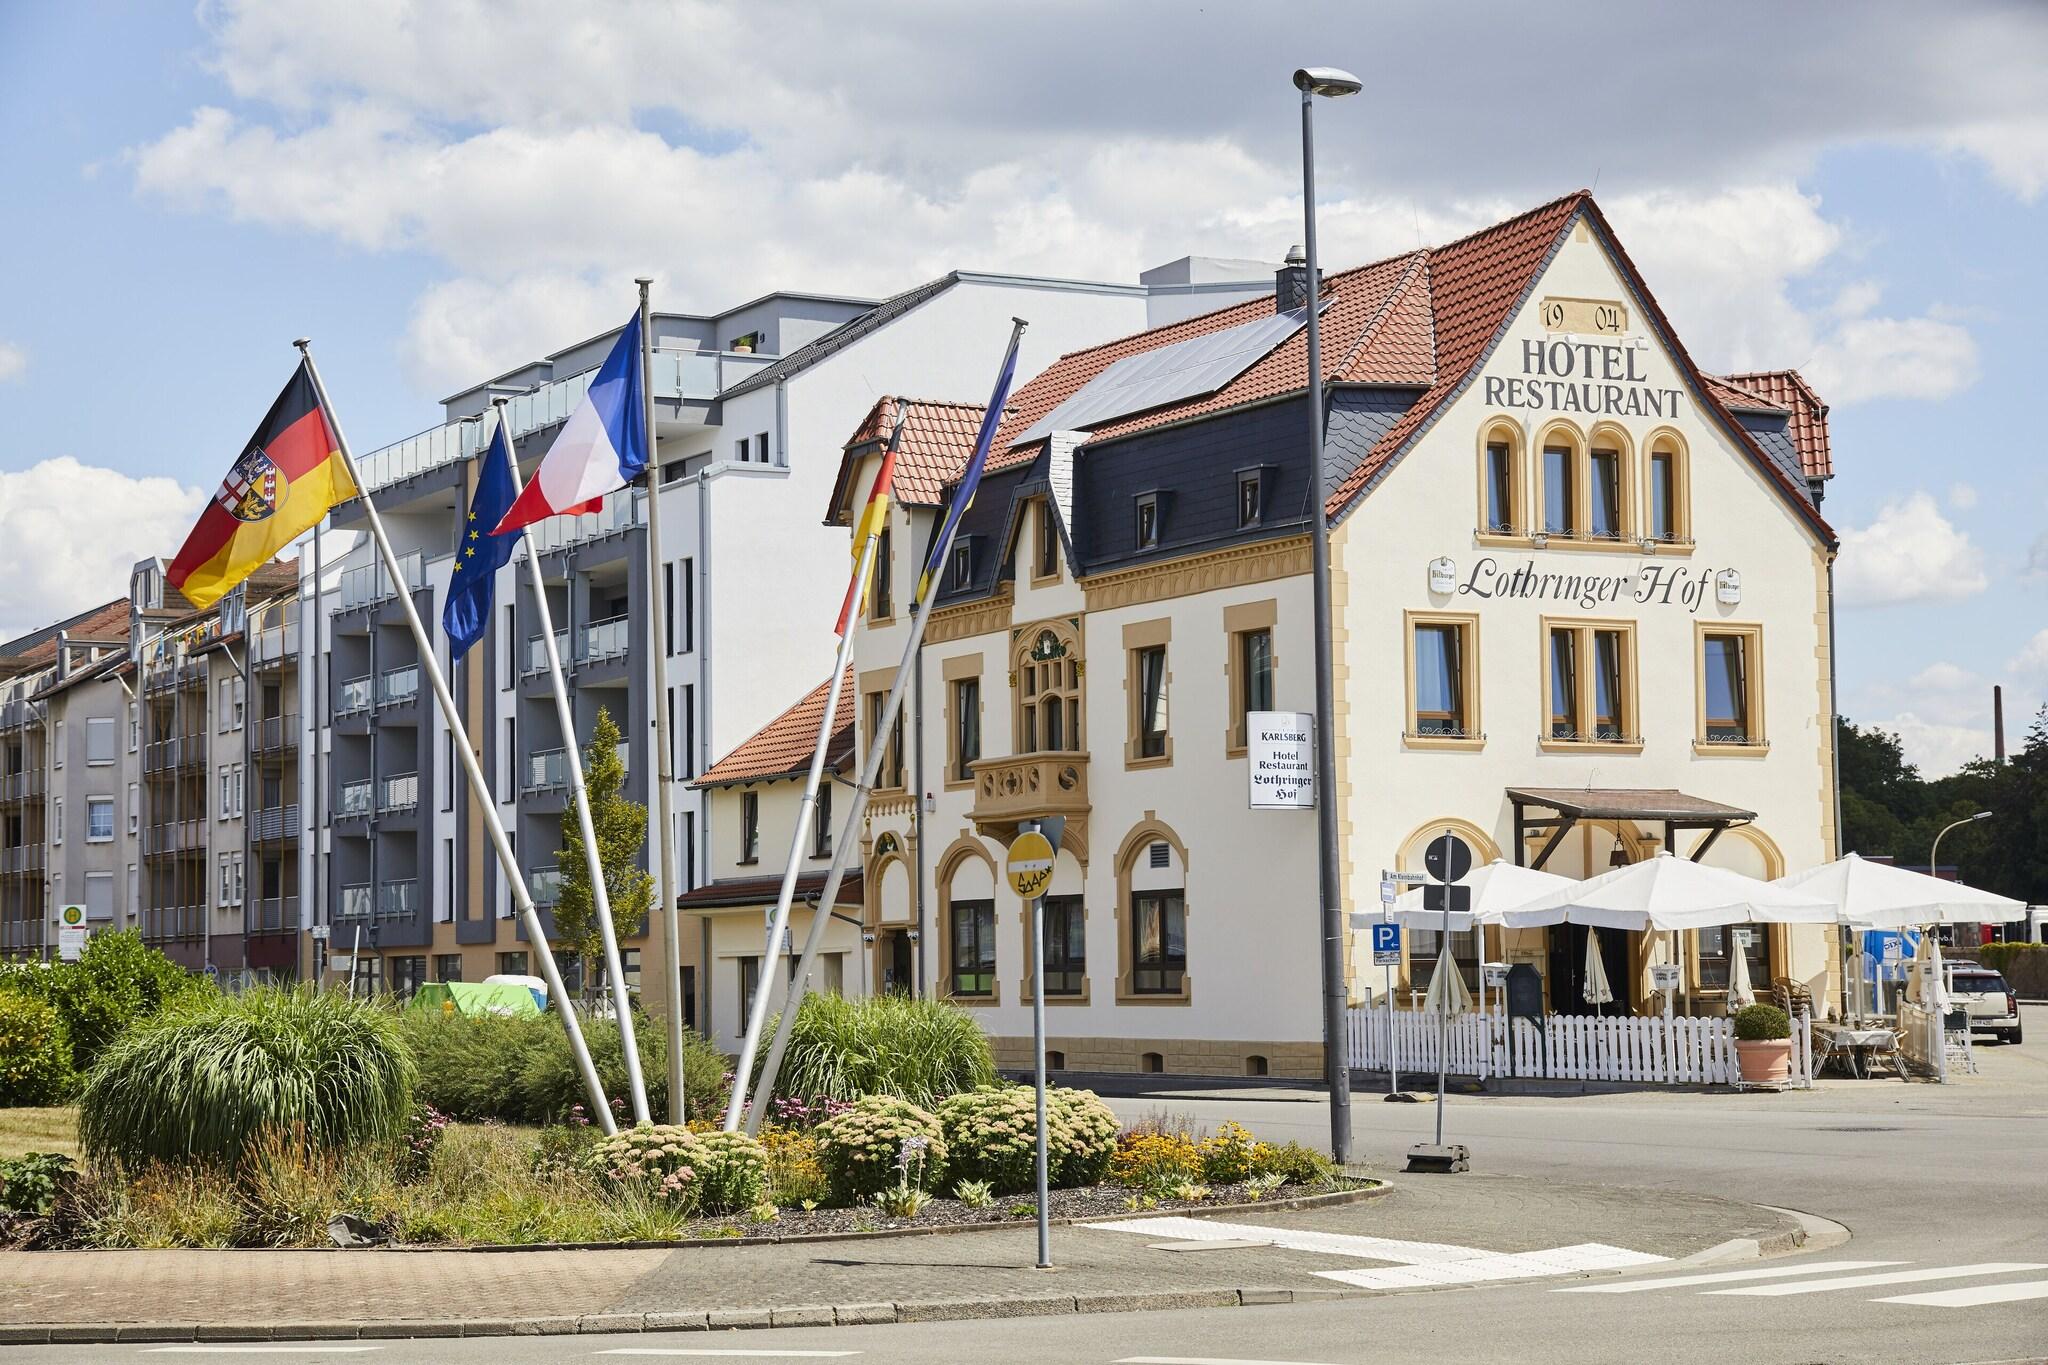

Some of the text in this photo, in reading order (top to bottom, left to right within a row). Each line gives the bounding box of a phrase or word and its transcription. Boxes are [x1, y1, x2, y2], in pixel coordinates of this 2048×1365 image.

[1543, 302, 1620, 333] 19 04
[1521, 338, 1648, 383] HOTEL
[1484, 375, 1685, 419] RESTAURANT
[1458, 557, 1713, 614] Lothringer Hof
[1261, 731, 1307, 742] KARLSBERG
[1272, 751, 1299, 761] Hotel
[1259, 760, 1308, 771] Restaurant
[1254, 773, 1312, 788] Lothringer
[1275, 788, 1298, 800] Hof
[1378, 927, 1394, 948] P
